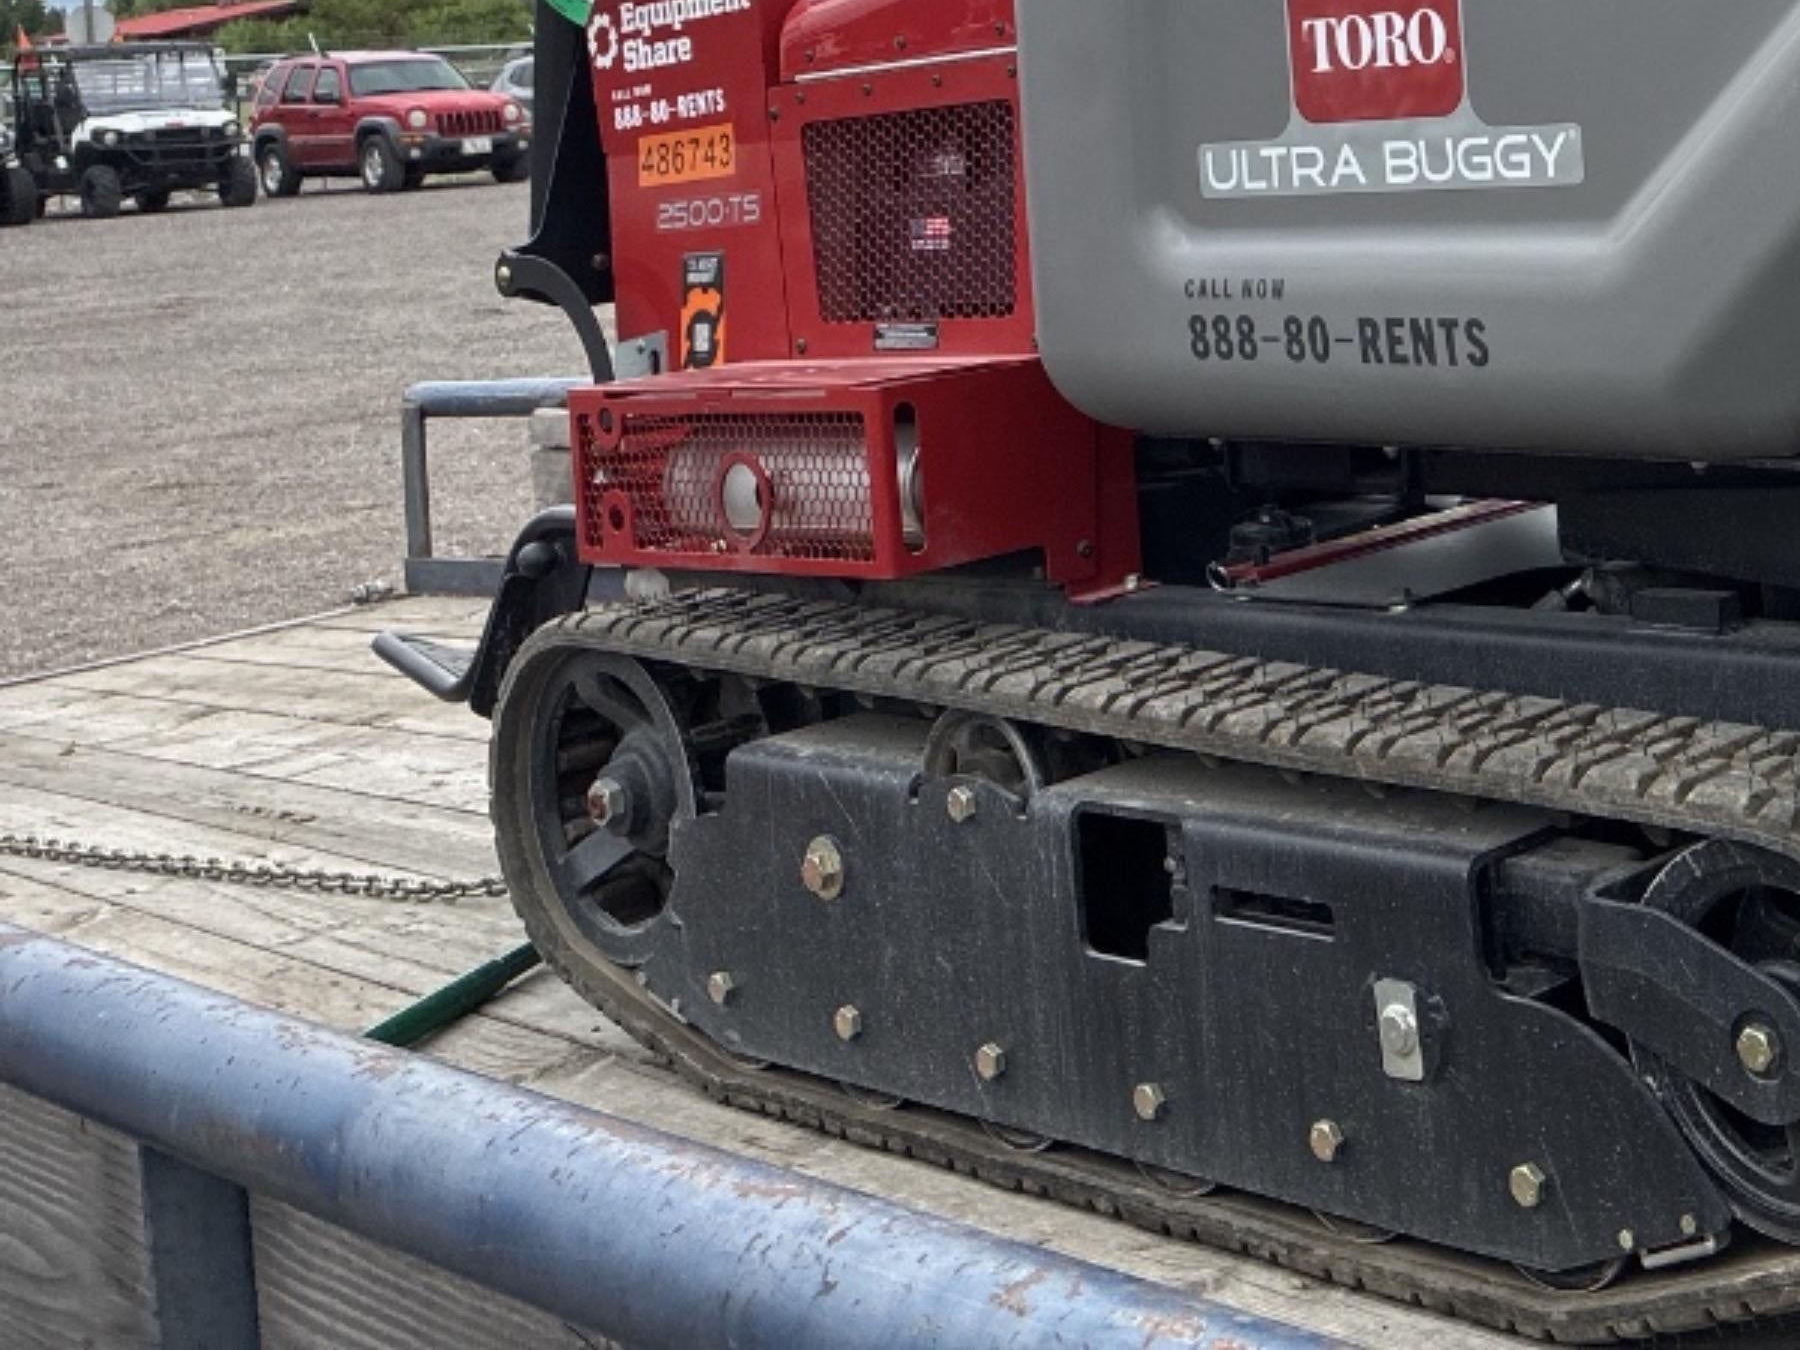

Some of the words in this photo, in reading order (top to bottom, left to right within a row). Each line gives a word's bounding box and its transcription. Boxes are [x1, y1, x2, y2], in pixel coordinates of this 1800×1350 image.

[623, 36, 693, 73] Share
[641, 132, 730, 176] 486743
[1205, 143, 1367, 190] ULTRA
[1383, 131, 1567, 185] BUGGY
[1184, 278, 1233, 299] CALL
[1241, 278, 1286, 300] NOW
[1188, 314, 1490, 367] 888-80-RENTS
